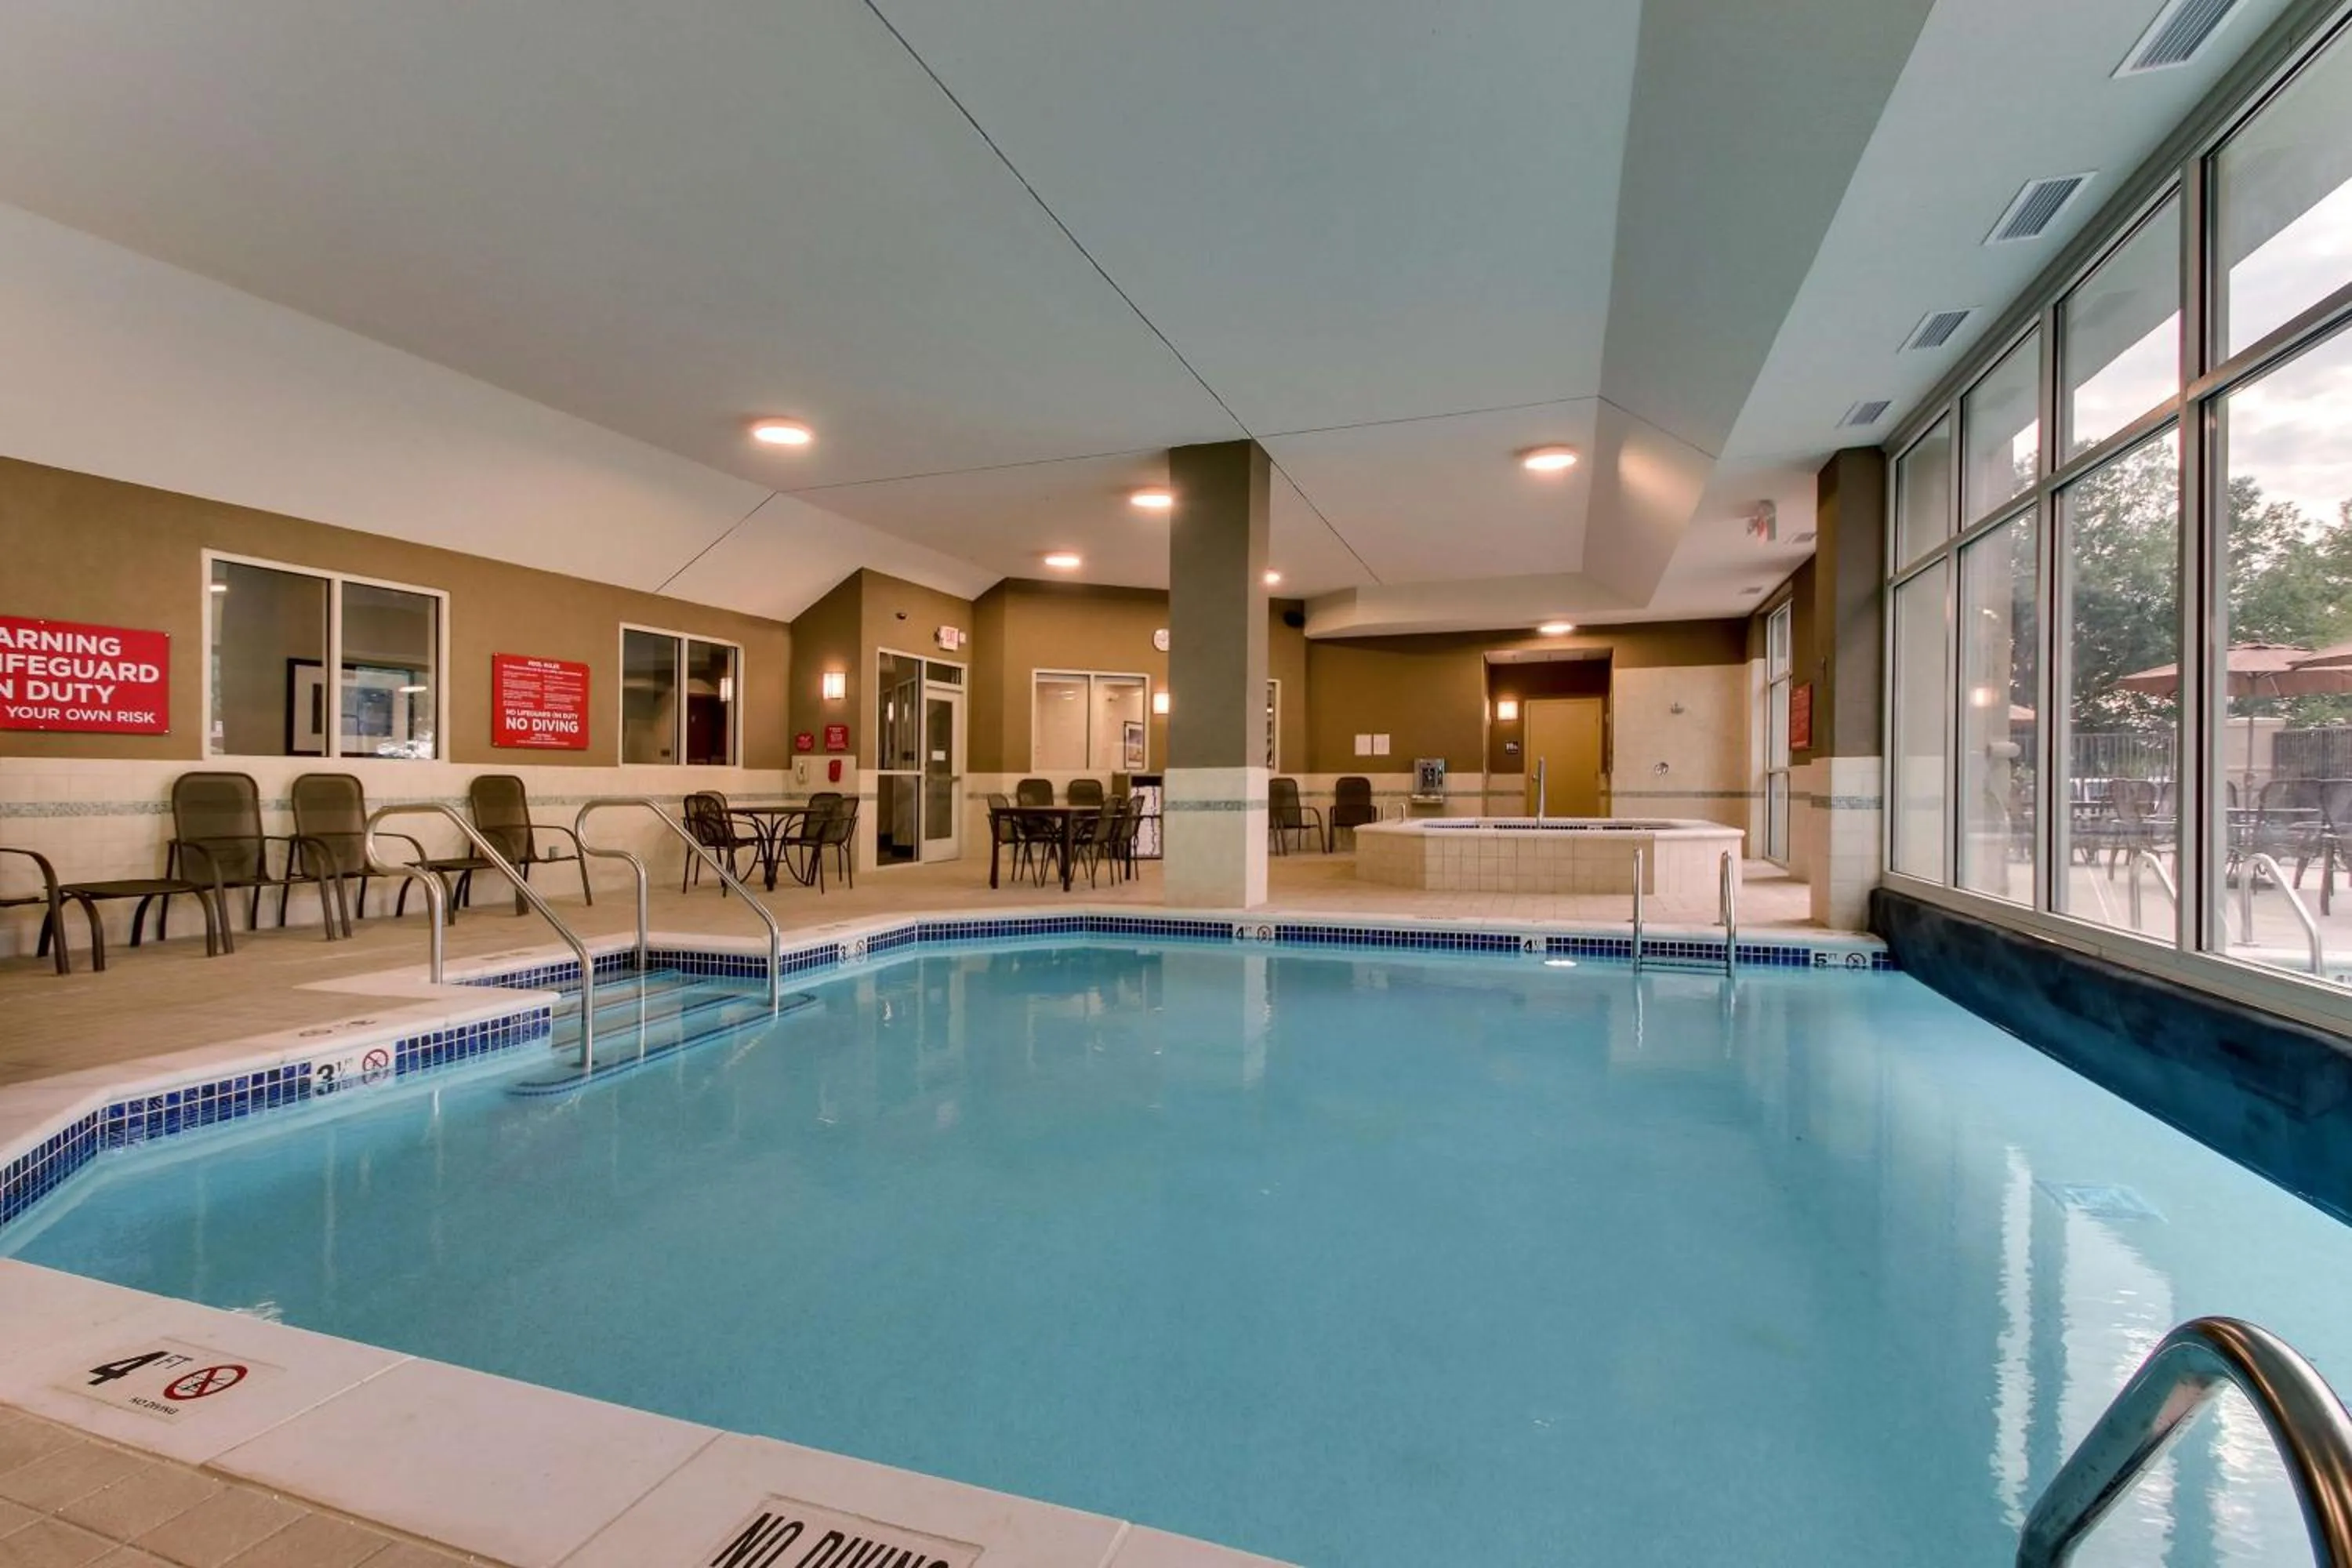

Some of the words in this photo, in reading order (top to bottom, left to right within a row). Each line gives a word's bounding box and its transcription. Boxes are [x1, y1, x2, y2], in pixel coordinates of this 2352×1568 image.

[0, 627, 122, 657] ARNING
[0, 653, 160, 684] FEGUARD
[26, 680, 116, 704] DUTY
[5, 706, 60, 720] YOUR
[66, 708, 111, 722] OWN
[117, 711, 155, 724] RISK
[506, 717, 528, 730] NO
[532, 719, 579, 734] DIVING
[88, 1351, 169, 1385] 4
[153, 1354, 194, 1369] FT
[710, 1512, 804, 1568] NO
